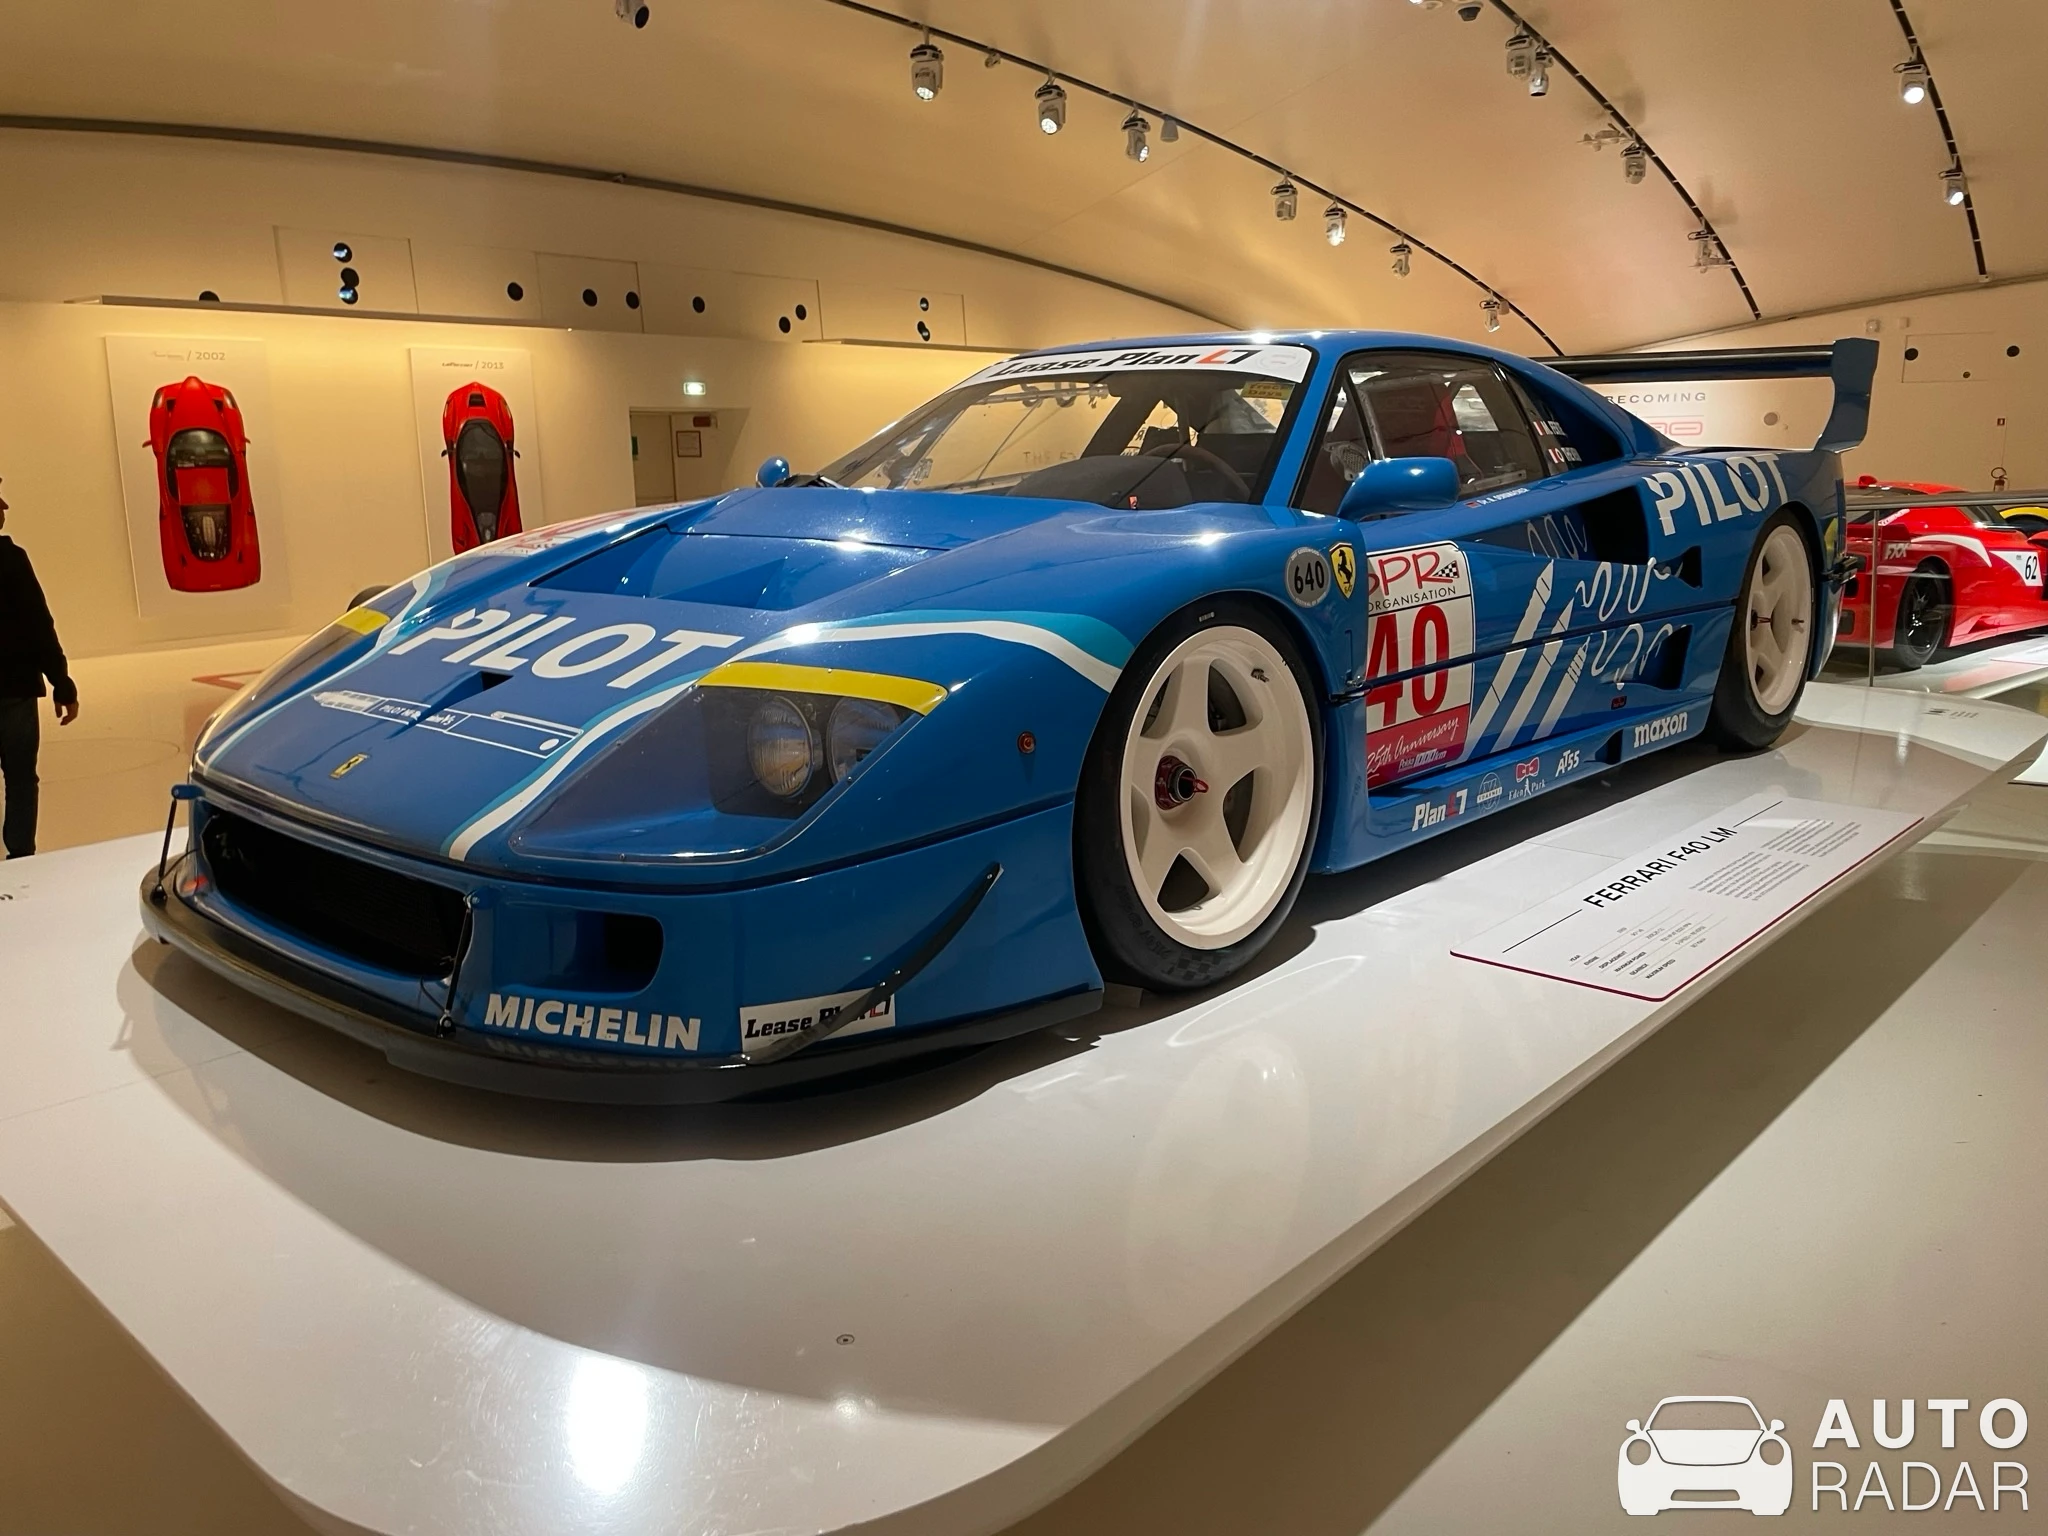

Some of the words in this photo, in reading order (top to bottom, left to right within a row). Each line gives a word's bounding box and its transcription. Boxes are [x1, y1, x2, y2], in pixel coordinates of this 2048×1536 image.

[195, 352, 226, 361] 2002
[481, 361, 504, 370] 2013
[987, 358, 1101, 378] Lease
[1098, 351, 1200, 367] Plan
[1641, 453, 1788, 536] PILOT
[1884, 543, 1910, 560] FXX
[2025, 555, 2037, 580] 62
[1294, 560, 1325, 595] 640
[388, 608, 745, 689] PILOT
[1365, 604, 1450, 727] 40
[1394, 717, 1459, 760] Anniversary
[1633, 711, 1688, 749] maxon
[1531, 778, 1546, 793] Park
[1412, 801, 1445, 832] Plan
[1583, 858, 1678, 908] FERRARI
[1667, 841, 1711, 861] F40
[1700, 827, 1738, 843] LM
[484, 993, 700, 1052] MICHELIN
[744, 1015, 812, 1039] Lease
